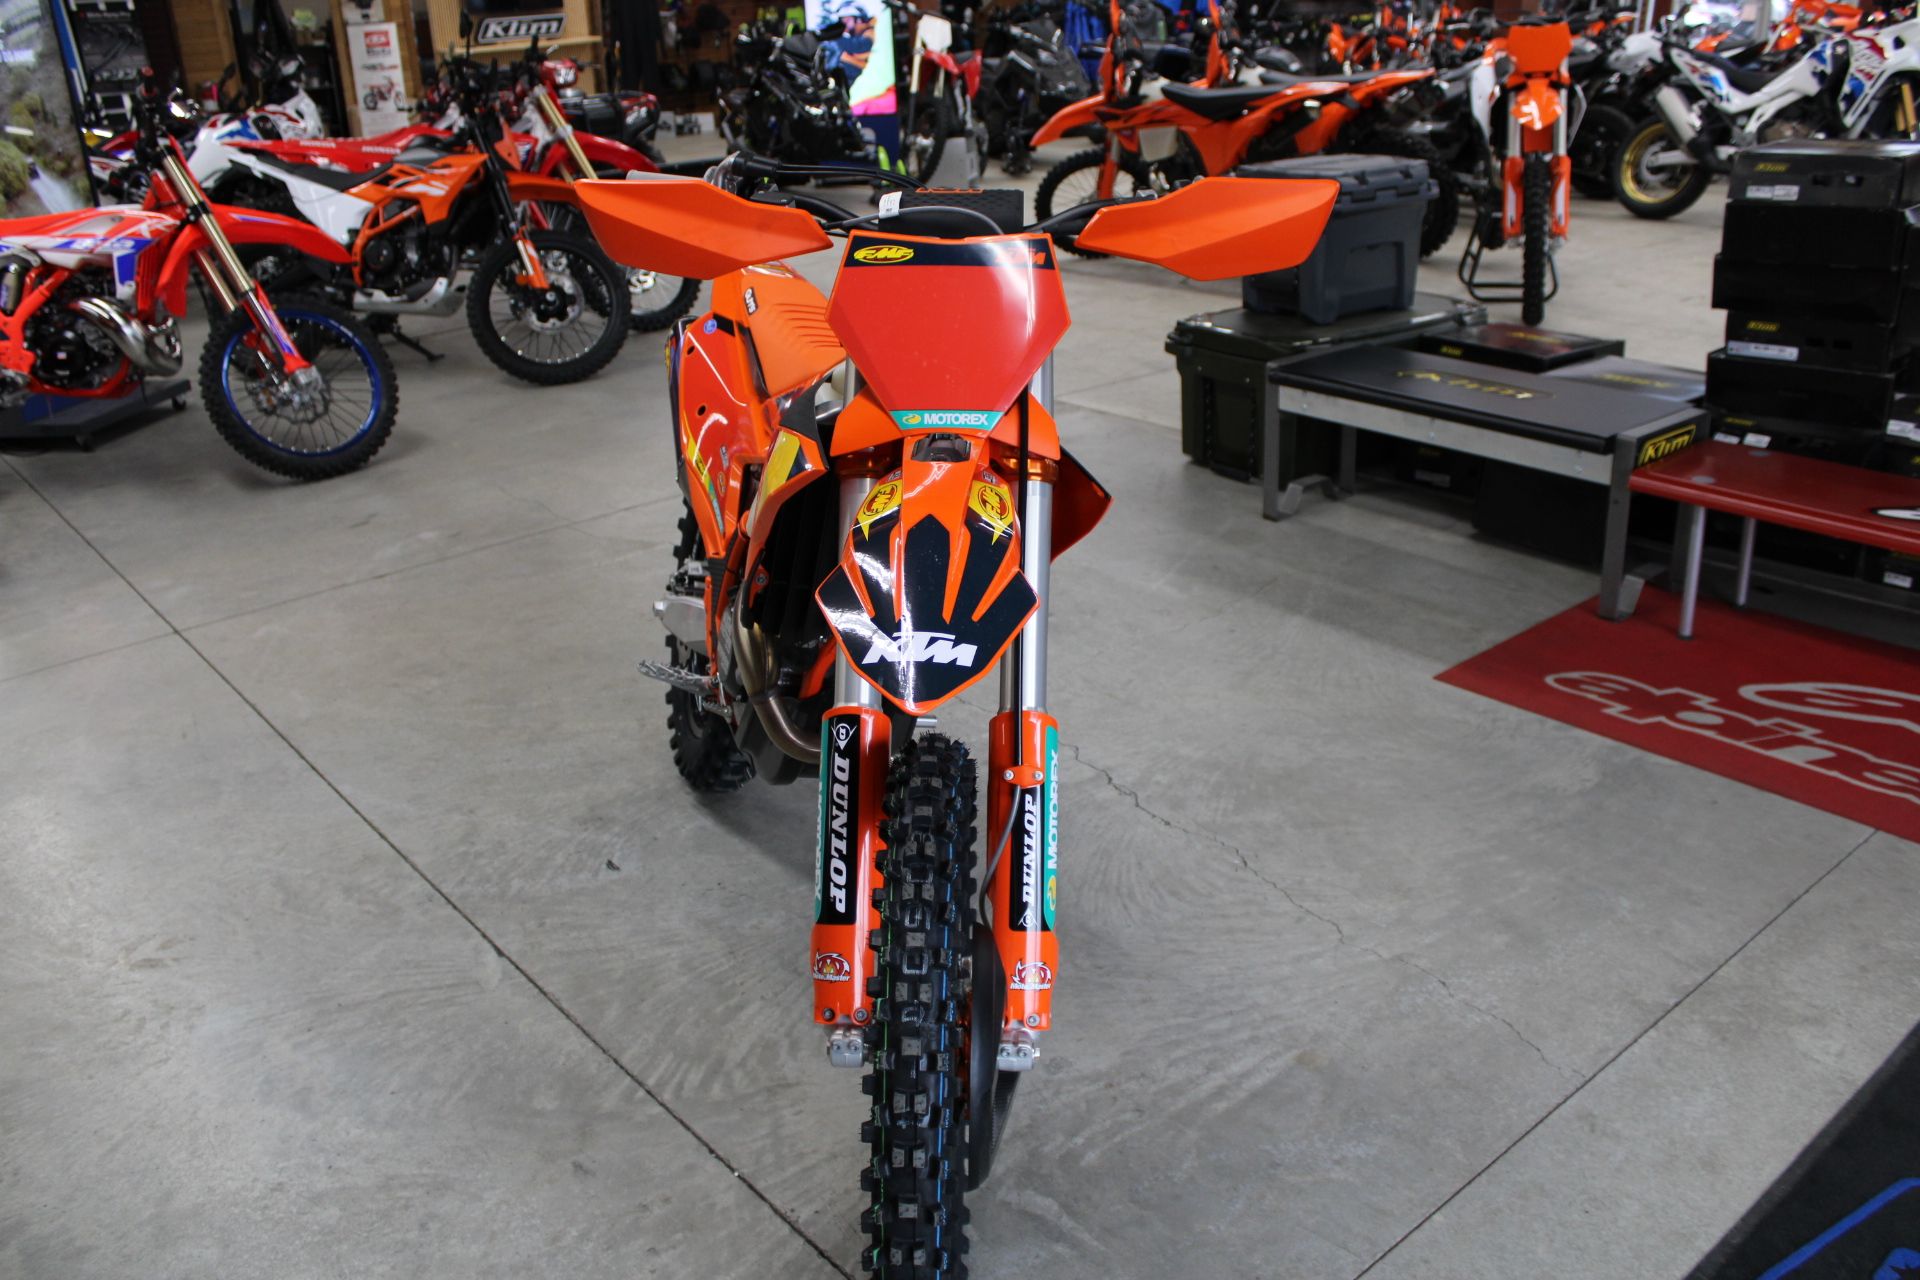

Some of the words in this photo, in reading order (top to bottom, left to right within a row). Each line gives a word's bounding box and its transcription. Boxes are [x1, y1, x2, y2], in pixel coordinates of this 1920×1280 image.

[485, 20, 560, 39] Klim
[854, 246, 914, 262] FMF
[923, 412, 989, 426] MOTOREX
[1643, 433, 1691, 465] Klim
[861, 631, 978, 667] KTM
[829, 752, 850, 913] DUNLOP
[1022, 794, 1038, 907] DUNLOP
